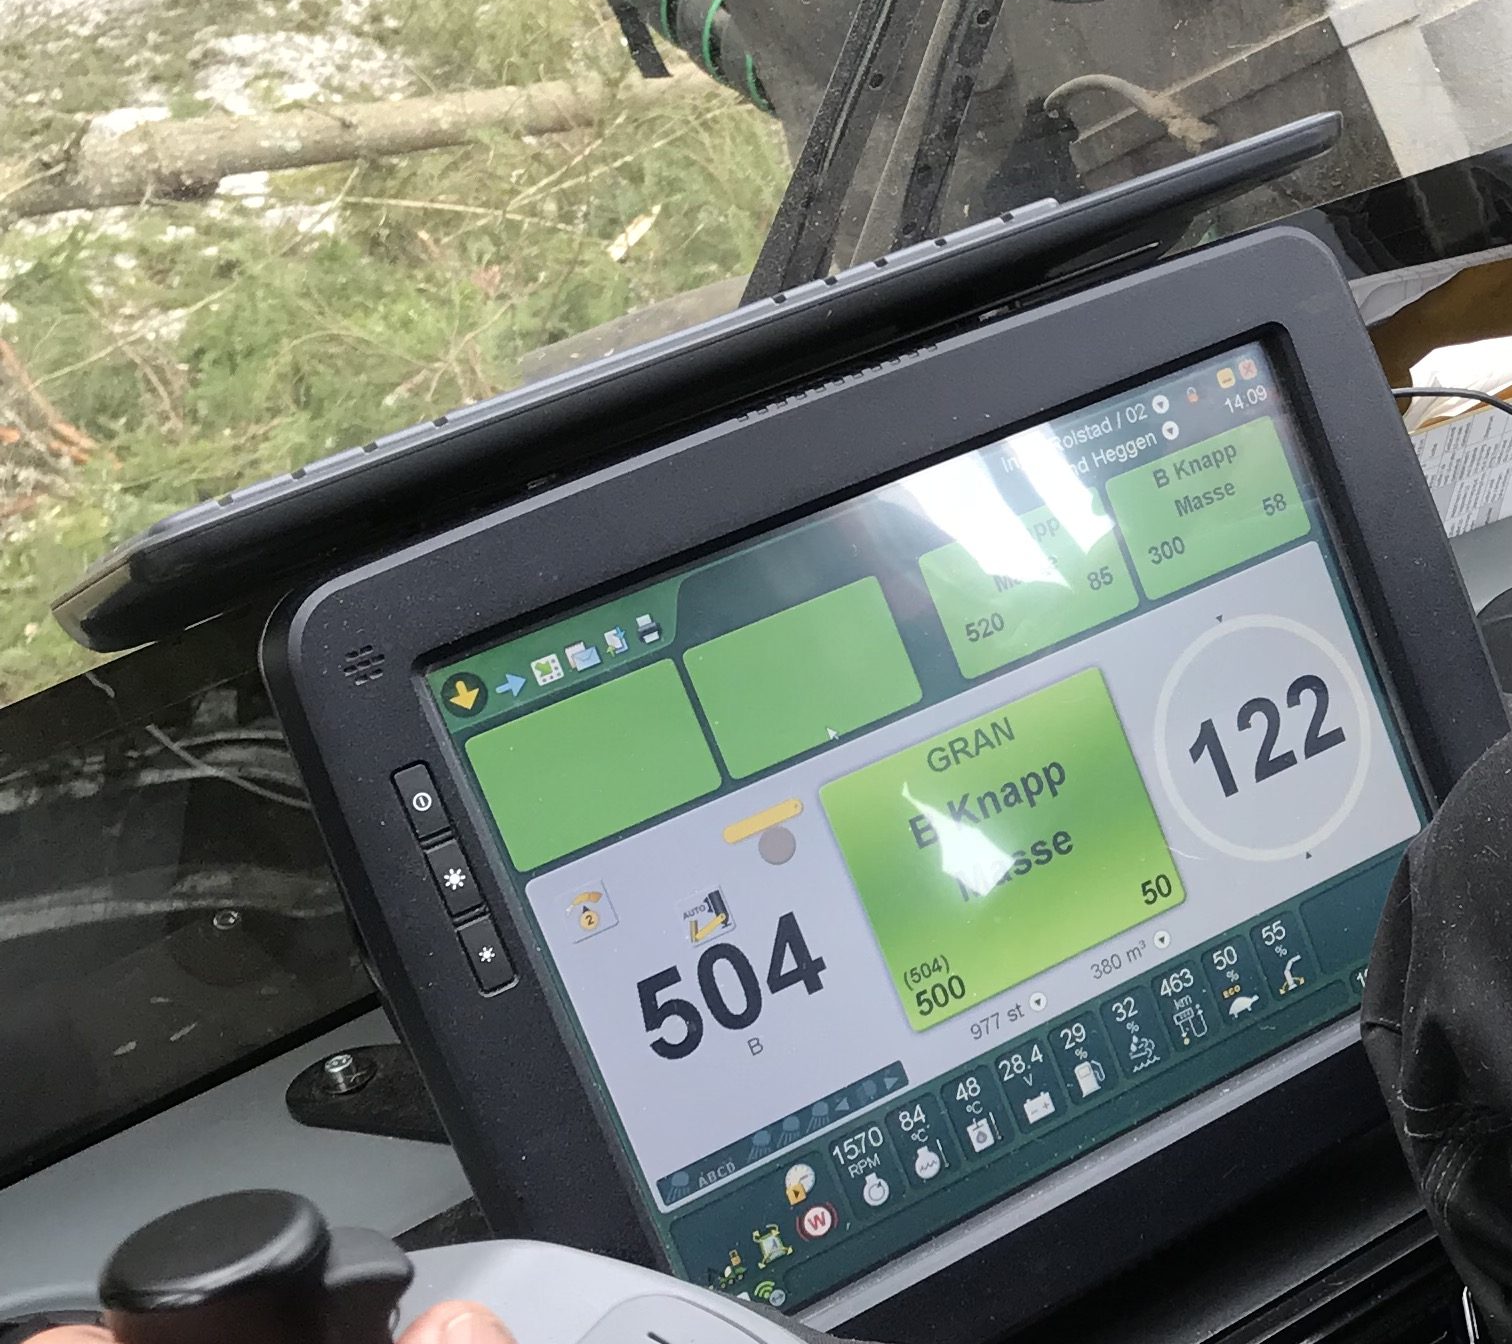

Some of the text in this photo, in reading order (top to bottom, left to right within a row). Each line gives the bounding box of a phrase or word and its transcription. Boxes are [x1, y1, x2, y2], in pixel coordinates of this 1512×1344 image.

[1126, 402, 1149, 424] 02
[1091, 431, 1158, 471] Heggen
[1152, 442, 1238, 489] B Knapp
[1174, 480, 1237, 518] Masse
[1262, 492, 1287, 517] 58
[1148, 535, 1185, 565] 300
[1087, 565, 1114, 591] 85
[964, 612, 1005, 642] 520
[926, 716, 1016, 773] GRAN
[1188, 674, 1347, 798] 122
[946, 761, 1067, 825] Knapp
[1140, 873, 1173, 906] 50
[584, 914, 595, 926] 2
[682, 904, 706, 921] AUTO
[1261, 919, 1287, 947] 55
[903, 953, 951, 992] (504)
[1090, 952, 1122, 981] 380
[1212, 945, 1239, 971] 50
[636, 911, 827, 1061] 504
[915, 974, 966, 1017] 500
[1159, 967, 1194, 998] 463
[1111, 996, 1139, 1023] 32
[1174, 994, 1193, 1011] km
[970, 1002, 1026, 1041] 977 st
[1059, 1022, 1087, 1050] 29
[747, 1036, 764, 1057] B
[998, 1044, 1044, 1082] 28.4
[955, 1076, 982, 1102] 48
[1023, 1072, 1034, 1087] V
[898, 1104, 927, 1132] 84
[832, 1126, 884, 1166] 1570
[847, 1153, 881, 1179] RPM
